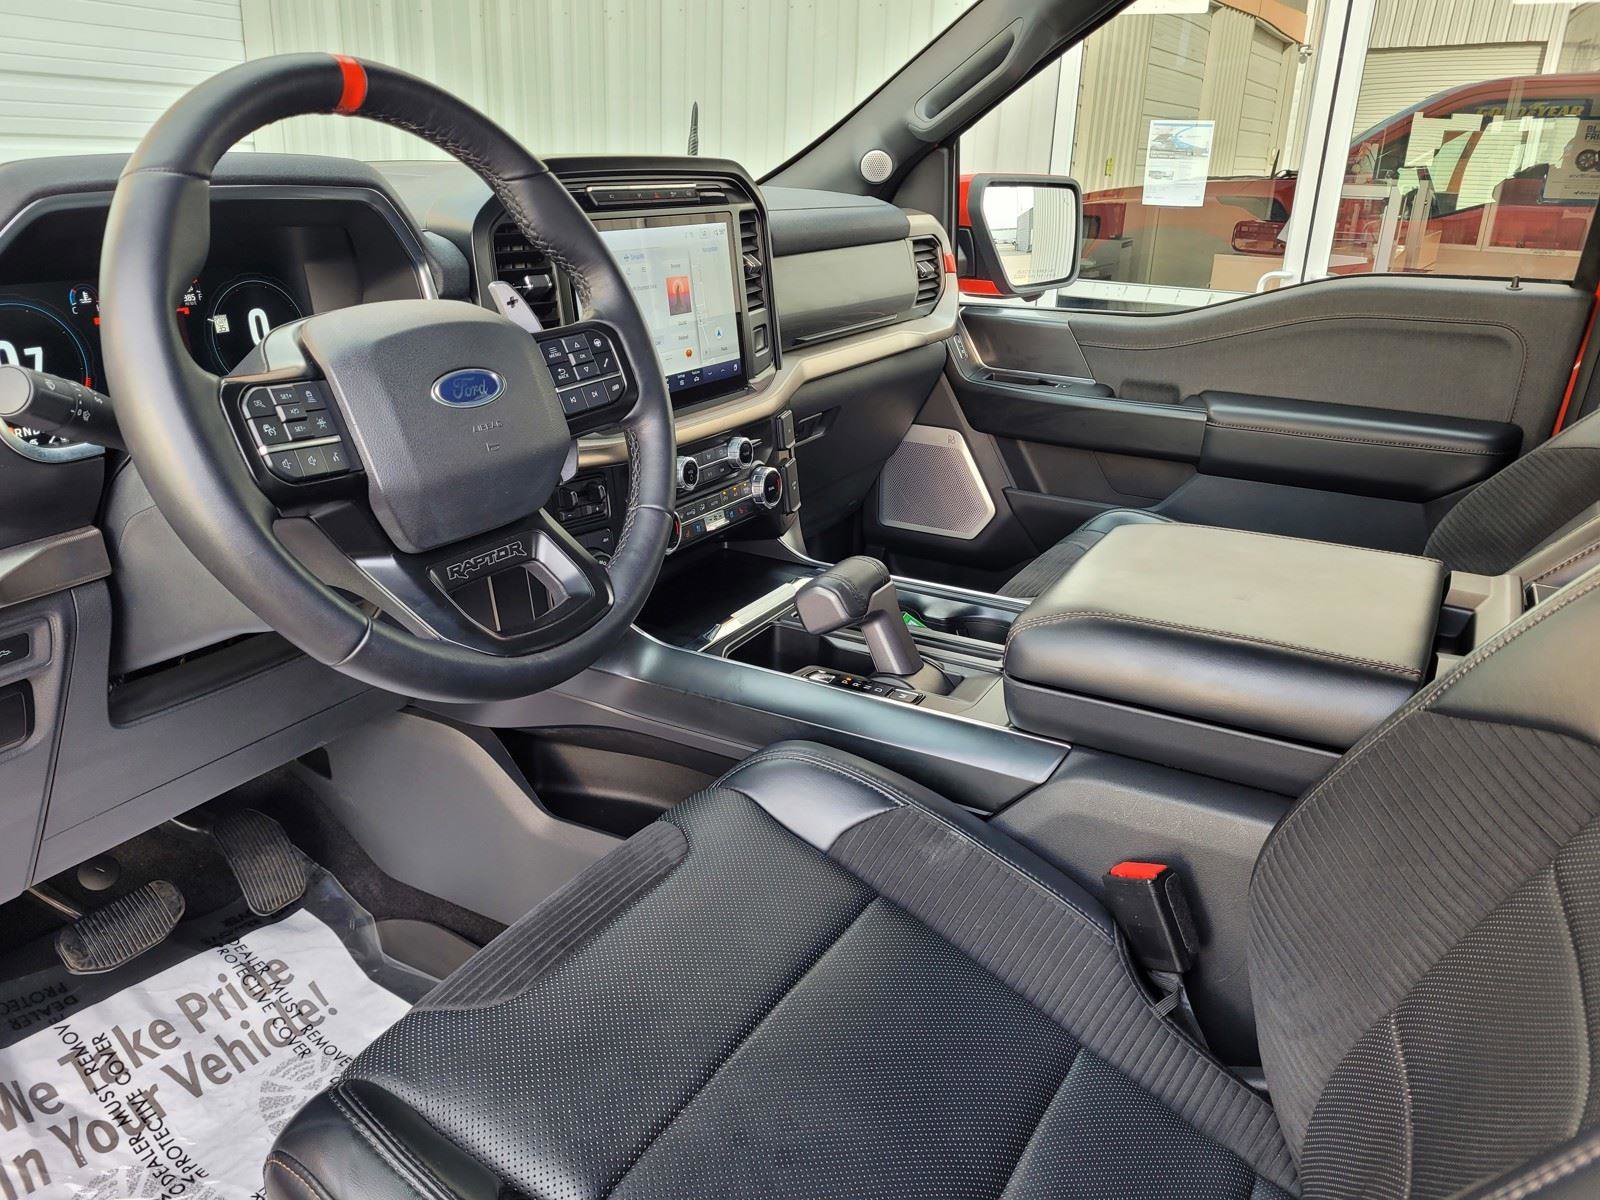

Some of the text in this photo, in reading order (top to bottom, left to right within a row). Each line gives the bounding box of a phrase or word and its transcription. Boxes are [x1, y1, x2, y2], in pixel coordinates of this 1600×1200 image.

[1475, 103, 1584, 117] GODYEAR
[452, 377, 489, 400] Ford
[446, 540, 528, 579] RAPTOR
[0, 982, 68, 1015] PROTEC
[0, 959, 295, 1132] We Take Pride
[217, 948, 277, 1014] ROTECTIVE
[272, 1016, 312, 1060] COVER
[229, 939, 271, 977] DEALER
[269, 980, 304, 1019] MUST
[300, 1023, 353, 1068] REMOVE
[47, 1083, 167, 1168] Your
[160, 980, 338, 1098] Vehicle!
[54, 1024, 177, 1187] DEALER MUST REMOV
[92, 1032, 198, 1174] PROTECTIVE COVER
